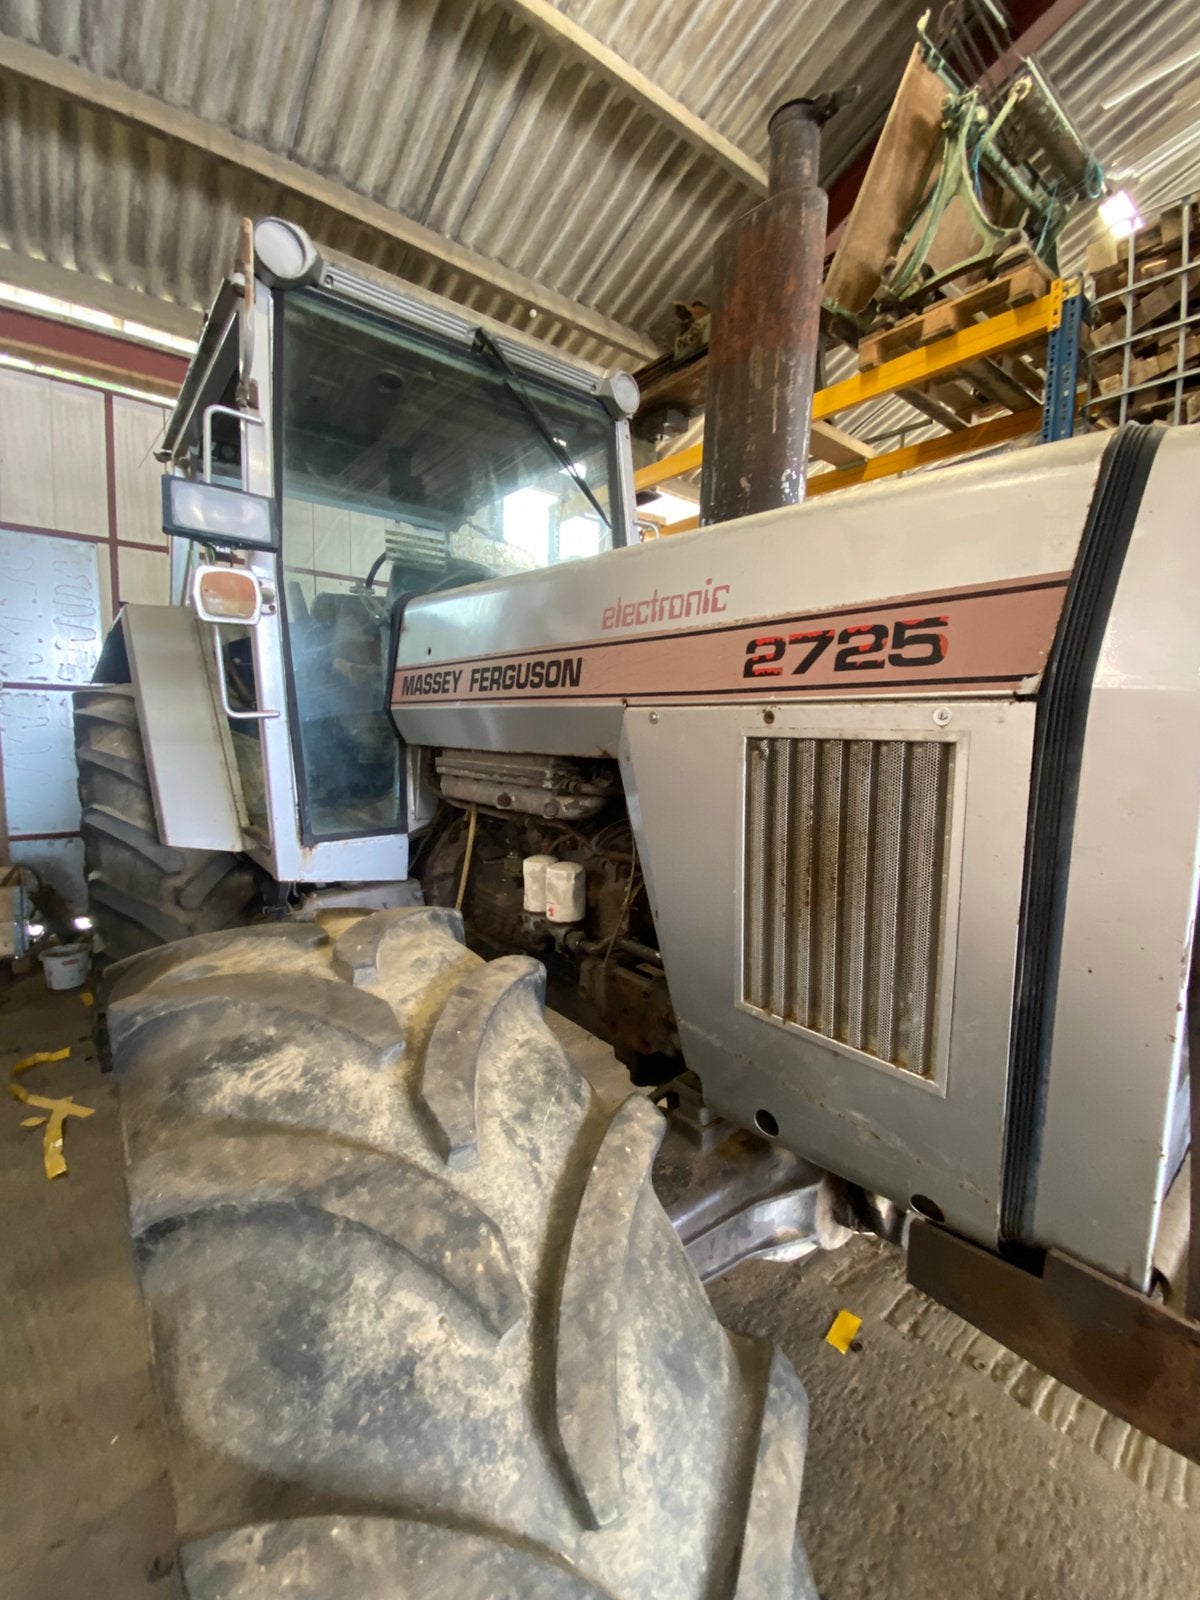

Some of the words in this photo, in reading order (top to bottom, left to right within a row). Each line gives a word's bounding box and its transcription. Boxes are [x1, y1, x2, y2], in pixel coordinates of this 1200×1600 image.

[601, 578, 730, 630] electronic
[743, 616, 950, 678] 2725
[401, 670, 463, 697] MASSEY
[469, 656, 583, 692] FERGUSON
